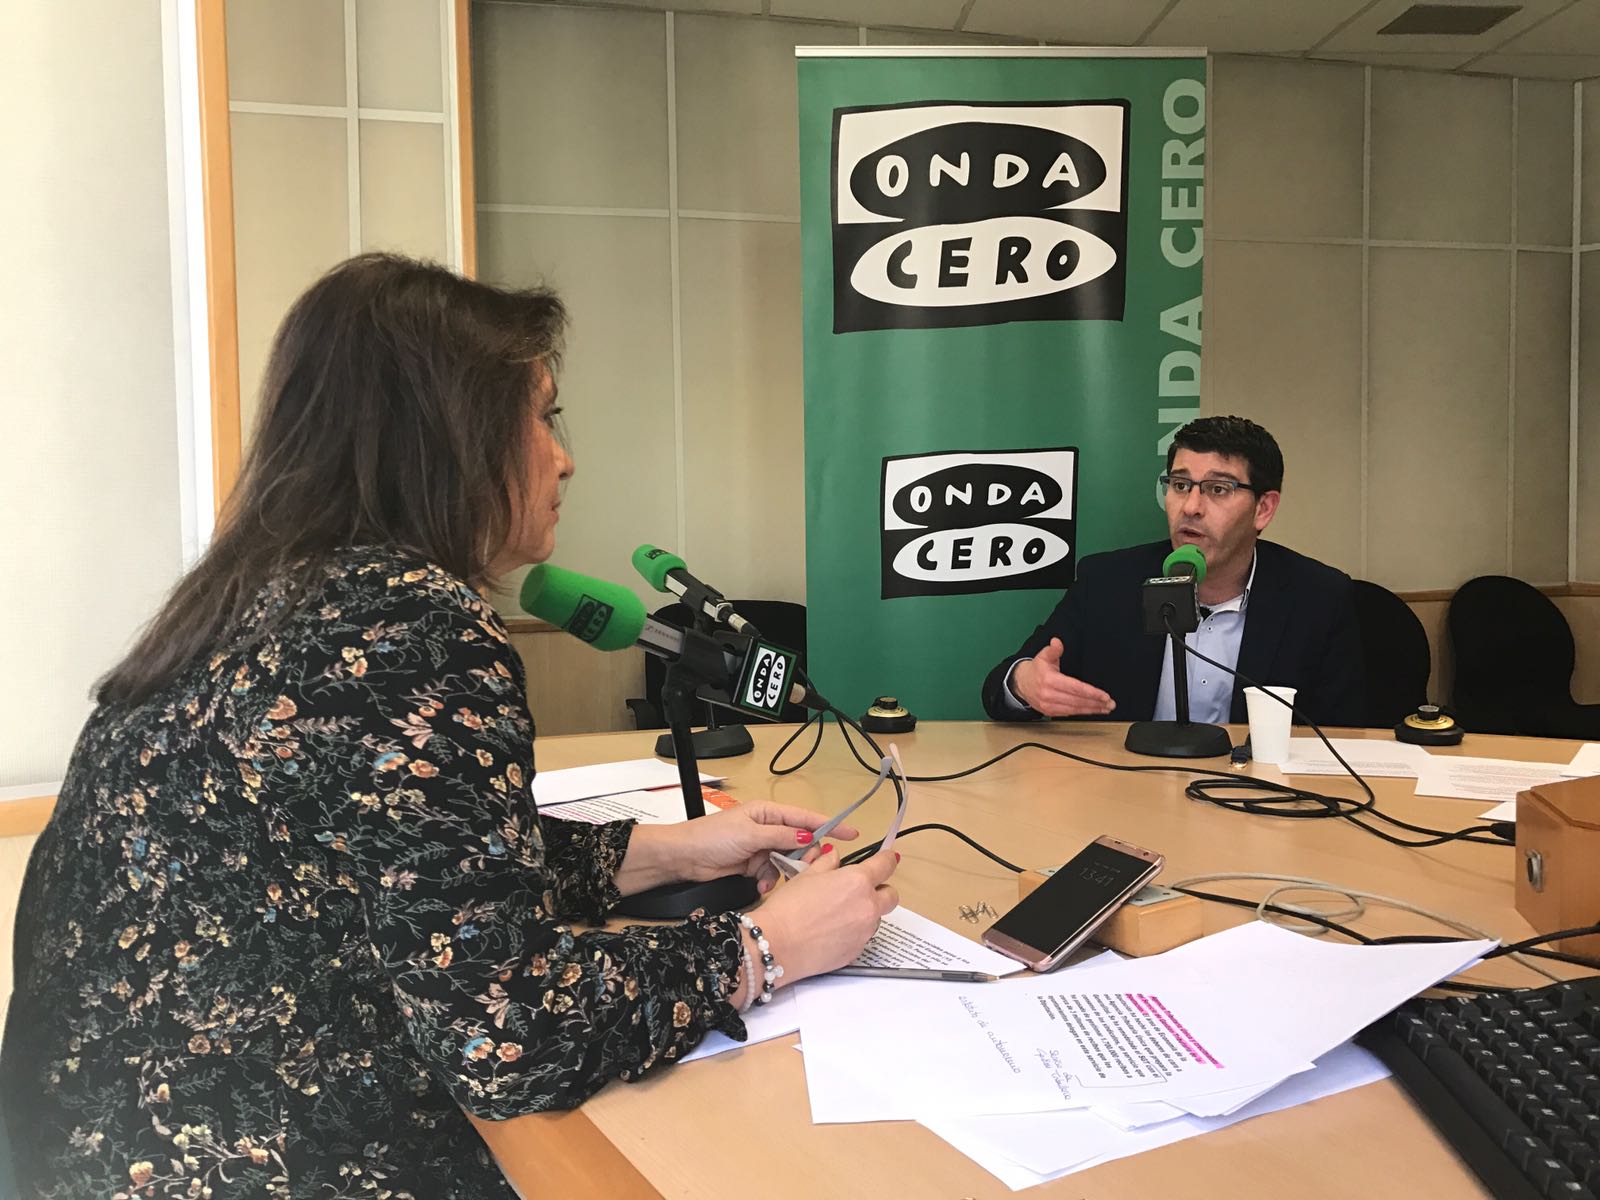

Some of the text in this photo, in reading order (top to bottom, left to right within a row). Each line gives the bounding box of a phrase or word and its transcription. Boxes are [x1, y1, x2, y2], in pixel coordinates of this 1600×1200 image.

[876, 152, 1080, 198] ONDA
[886, 236, 1081, 290] CERO
[1156, 296, 1203, 511] NDA
[910, 482, 1046, 513] ONDA
[916, 536, 1046, 571] CERO
[754, 658, 770, 698] ONDA
[768, 662, 784, 700] CERO
